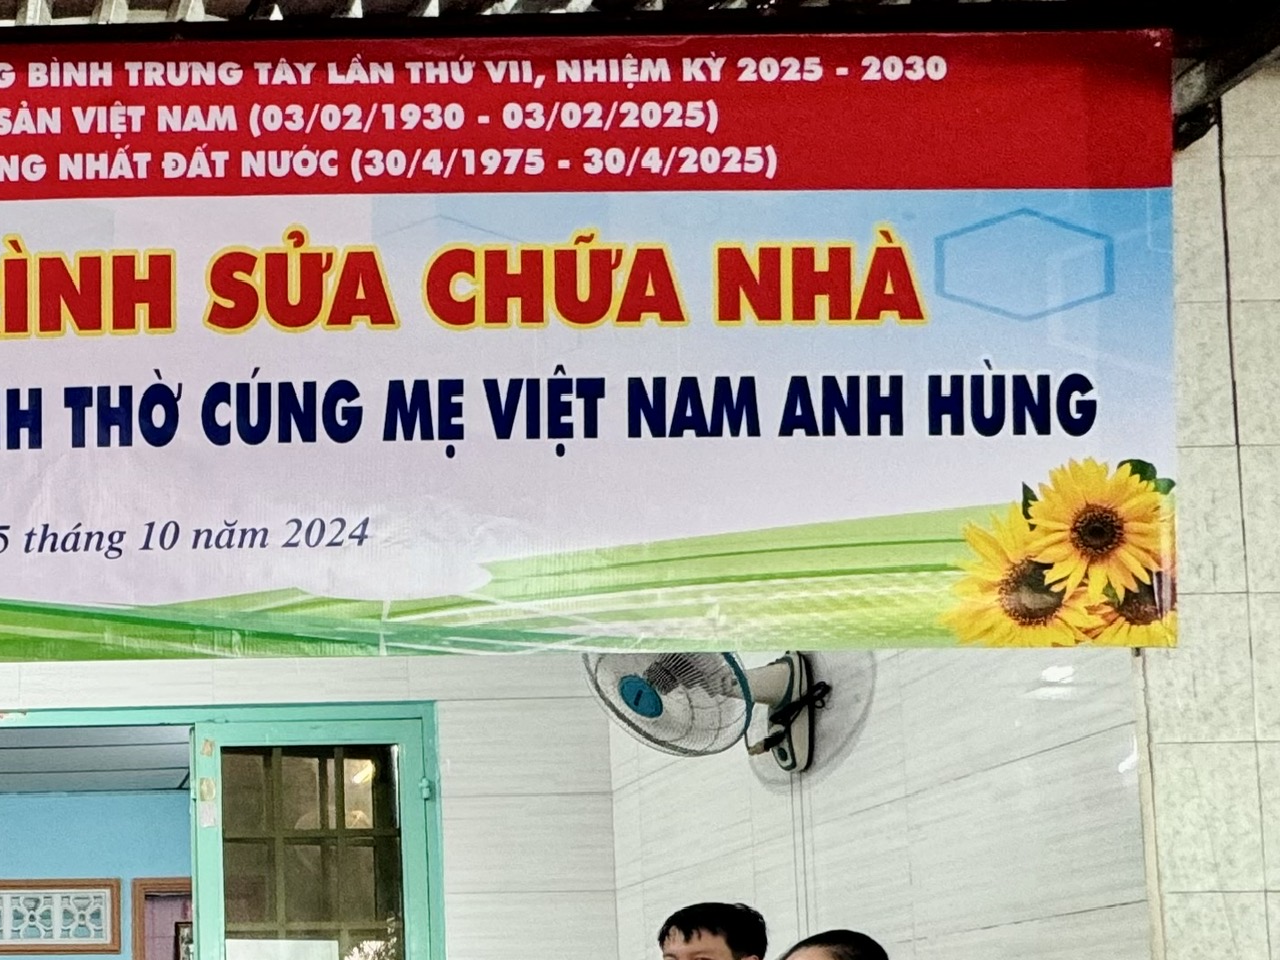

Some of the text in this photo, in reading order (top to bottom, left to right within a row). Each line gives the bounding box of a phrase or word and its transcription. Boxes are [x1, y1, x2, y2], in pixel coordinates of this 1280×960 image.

[27, 58, 113, 89] BÌNH
[125, 60, 243, 87] TRƯNG
[254, 57, 317, 86] TÂY
[327, 53, 395, 85] LẦN
[405, 55, 475, 84] THỨ
[483, 59, 545, 89] VII,
[556, 53, 671, 89] NHIỆM
[682, 51, 727, 82] KỲ
[737, 56, 822, 82] 2025
[836, 66, 849, 77] -
[860, 55, 948, 81] 2030
[71, 101, 146, 139] VIỆT
[157, 105, 238, 132] NAM
[249, 102, 466, 138] (03/02/1930
[477, 116, 490, 125] -
[502, 99, 718, 134] 03/02/2025)
[59, 146, 151, 181] NHẤT
[161, 145, 229, 179] ĐẤT
[241, 145, 339, 178] NƯỚC
[350, 148, 545, 183] (30/4/1975
[558, 161, 570, 170] -
[583, 145, 778, 179] 30/4/2025)
[204, 225, 401, 334] SỬA
[423, 228, 688, 327] CHỮA
[714, 227, 927, 326] NHÀ
[63, 369, 183, 449] THỜ
[200, 367, 364, 447] CÚNG
[382, 378, 466, 460] MẸ
[482, 364, 606, 458] VIỆT
[626, 375, 761, 439] NAM
[778, 373, 904, 438] ANH
[927, 359, 1098, 438] HÙNG
[24, 522, 127, 560] tháng
[138, 520, 180, 551] 10
[191, 519, 269, 551] năm
[281, 516, 370, 548] 2024
